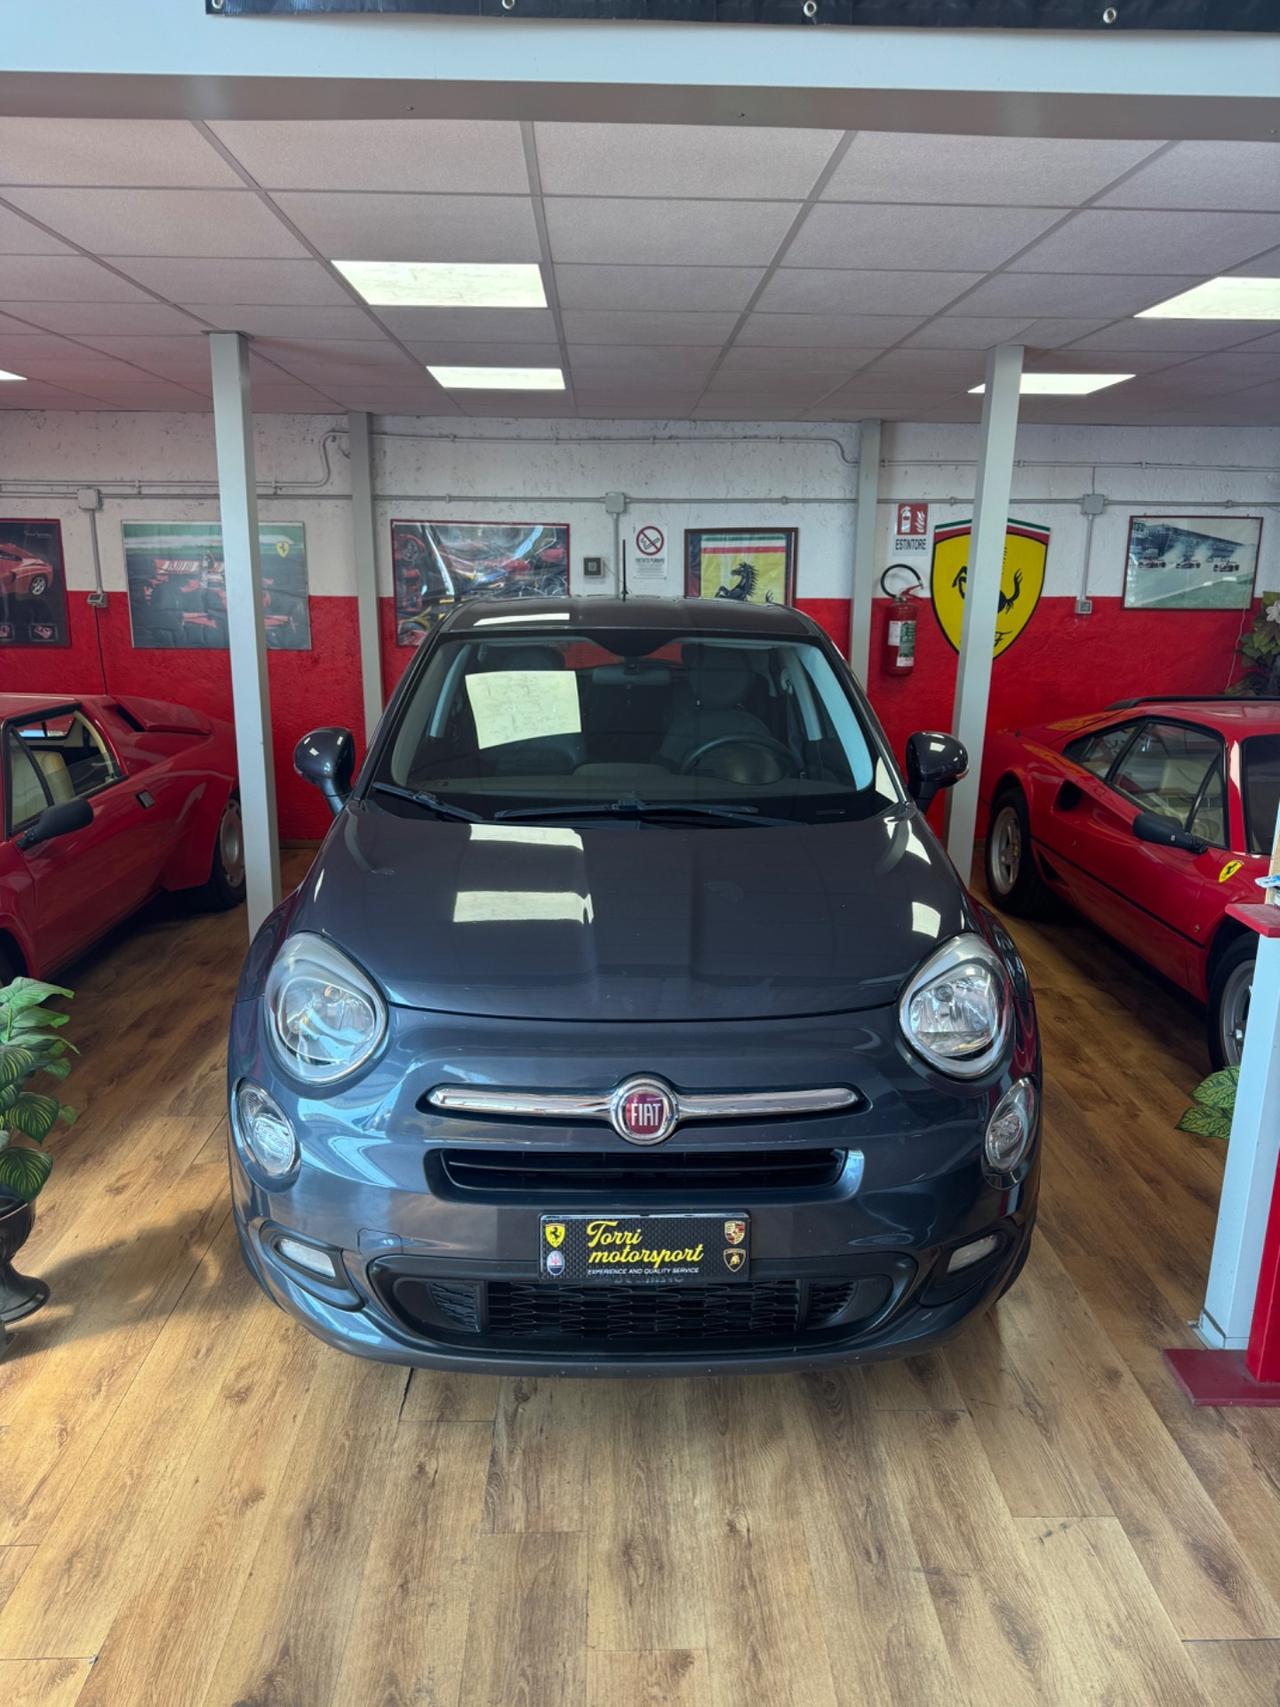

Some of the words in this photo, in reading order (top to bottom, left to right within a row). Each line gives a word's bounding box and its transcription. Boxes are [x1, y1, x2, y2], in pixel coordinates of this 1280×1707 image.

[895, 538, 927, 551] ESTINTORE
[630, 1103, 662, 1126] FIAT
[586, 1220, 642, 1248] Torri
[588, 1244, 704, 1268] motorsport
[644, 1267, 671, 1275] QUALITY
